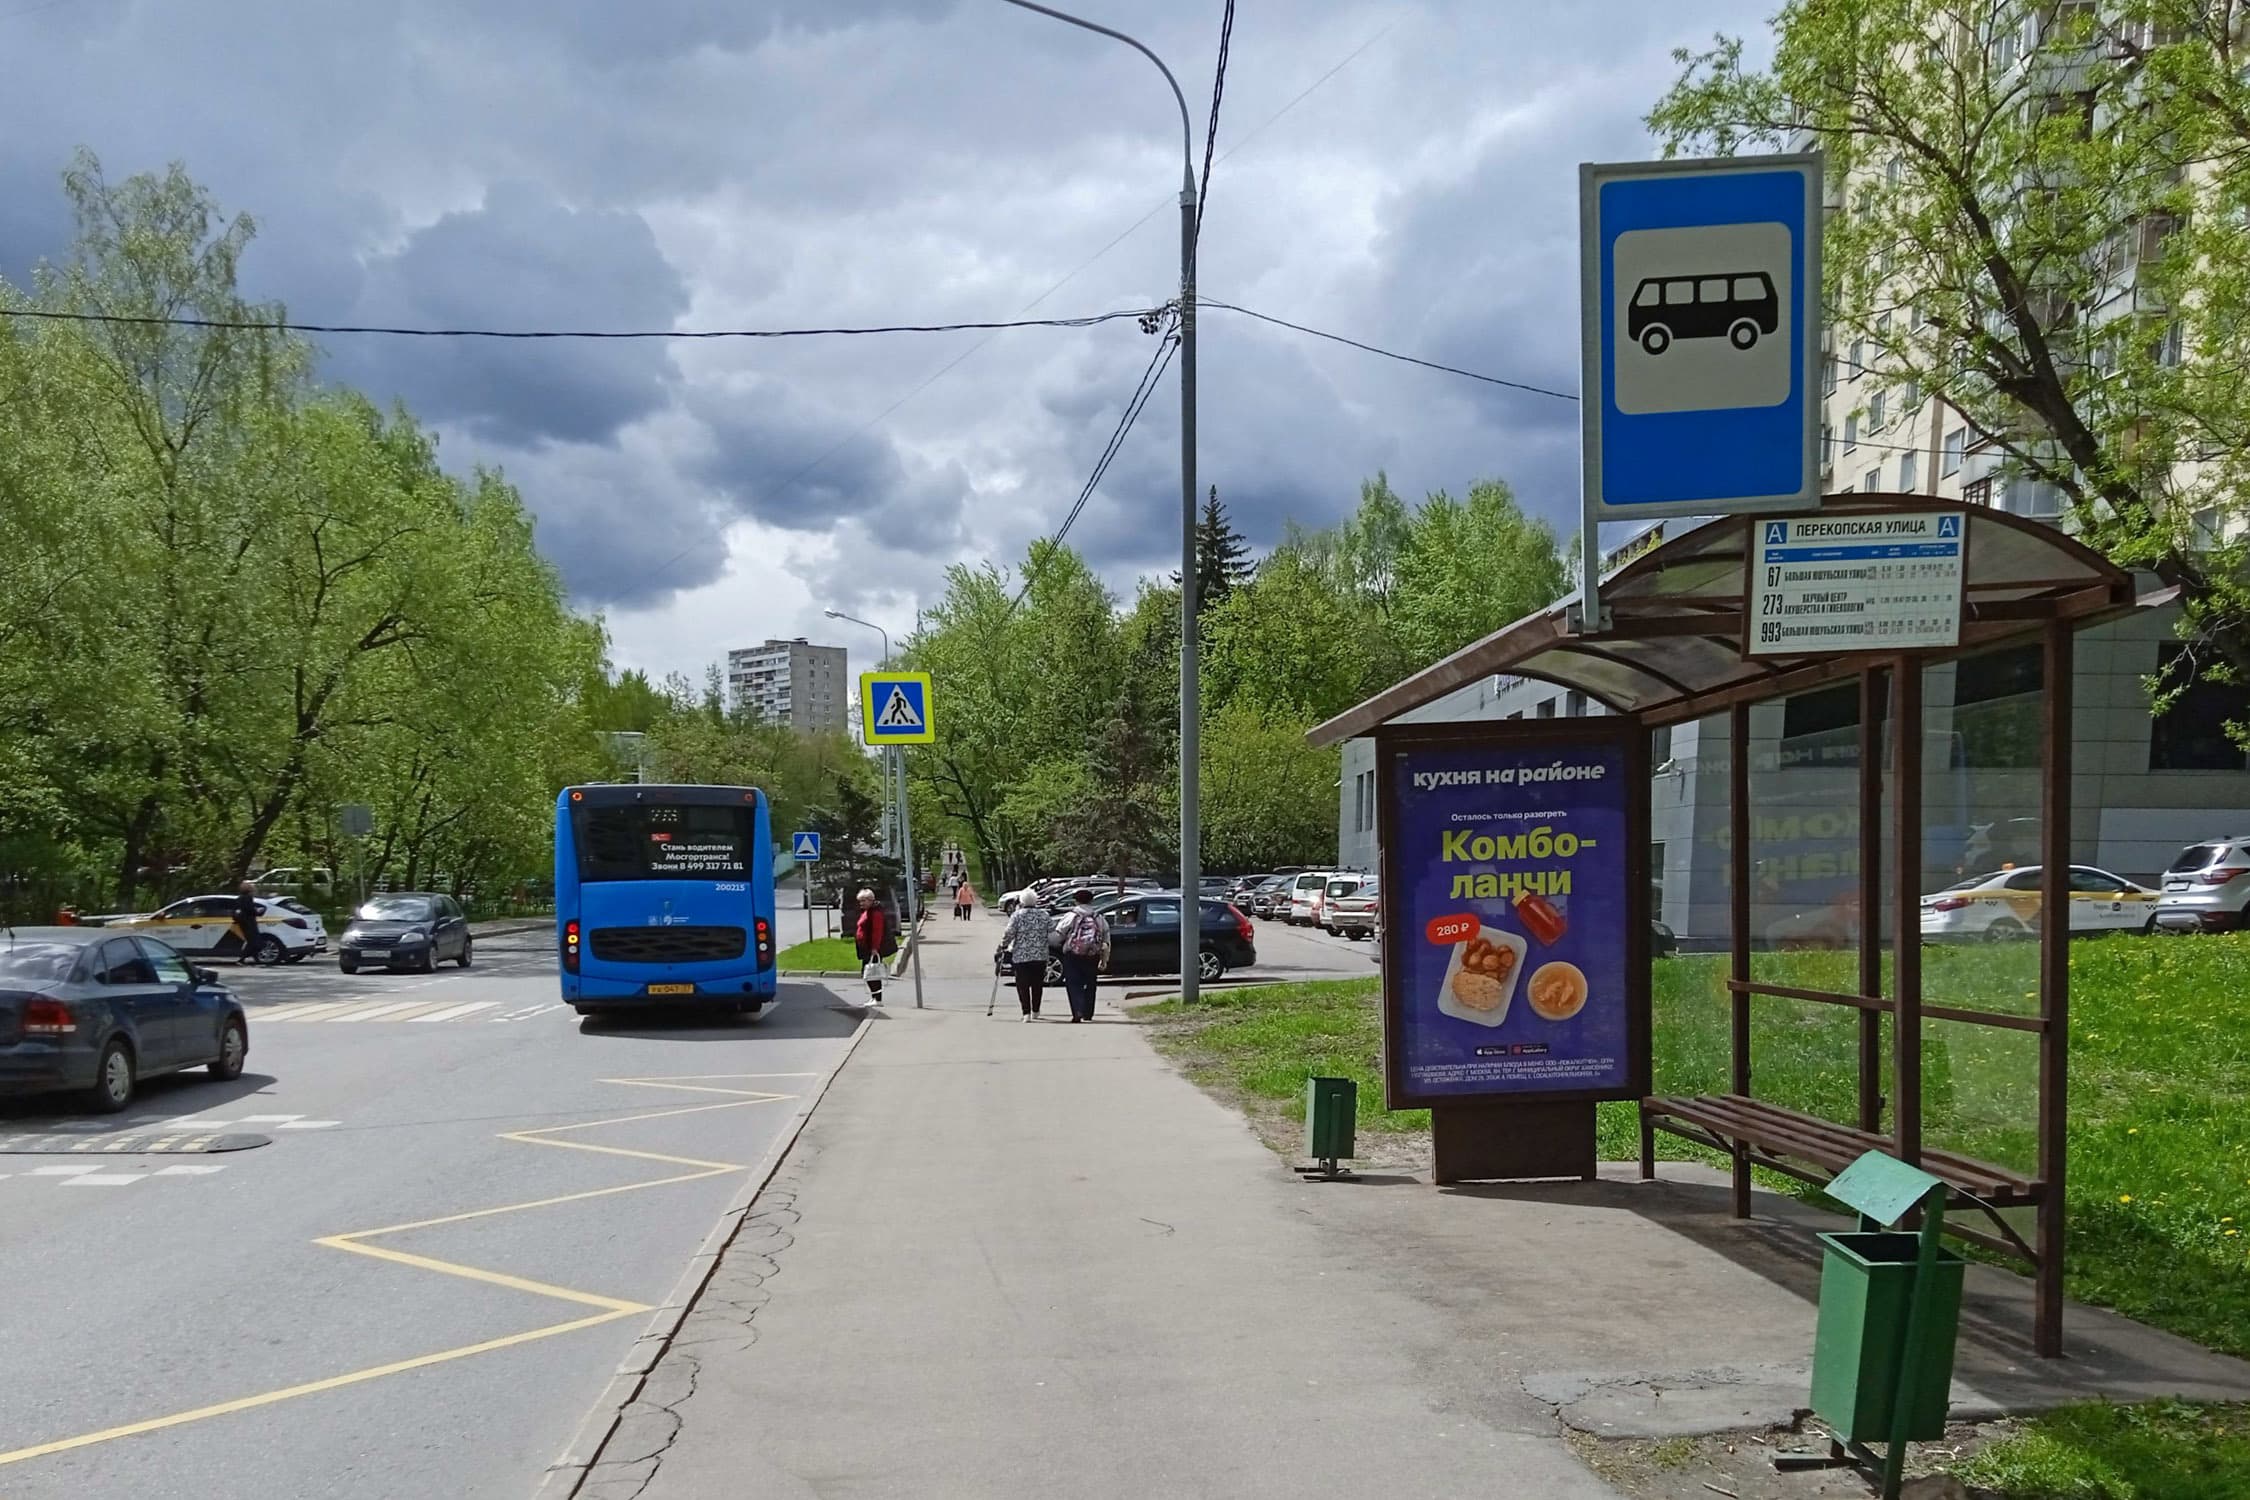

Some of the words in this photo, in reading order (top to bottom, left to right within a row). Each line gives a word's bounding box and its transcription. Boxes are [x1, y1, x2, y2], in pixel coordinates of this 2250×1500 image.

[1796, 521, 1882, 537] ПЕРЕКОПСКАЯ
[1886, 520, 1926, 534] УЛИЦА
[1768, 567, 1781, 587] 67
[1763, 595, 1783, 615] 273
[1761, 622, 1781, 643] 993
[1413, 770, 1481, 791] кухня
[1486, 769, 1514, 784] на
[1519, 761, 1605, 786] районе
[1451, 813, 1492, 821] Осталось
[1493, 812, 1523, 820] только
[1524, 810, 1567, 820] разогреть
[661, 843, 686, 851] Стань
[1442, 826, 1597, 862] Комбо-
[651, 862, 678, 870] Звони
[680, 862, 686, 870] 8
[688, 862, 704, 870] 499
[706, 862, 720, 870] 317
[722, 862, 732, 870] 71
[733, 862, 743, 870] 81
[665, 853, 730, 861] Мосгортранса!
[1450, 870, 1571, 899] ланчи
[1437, 924, 1458, 937] 280
